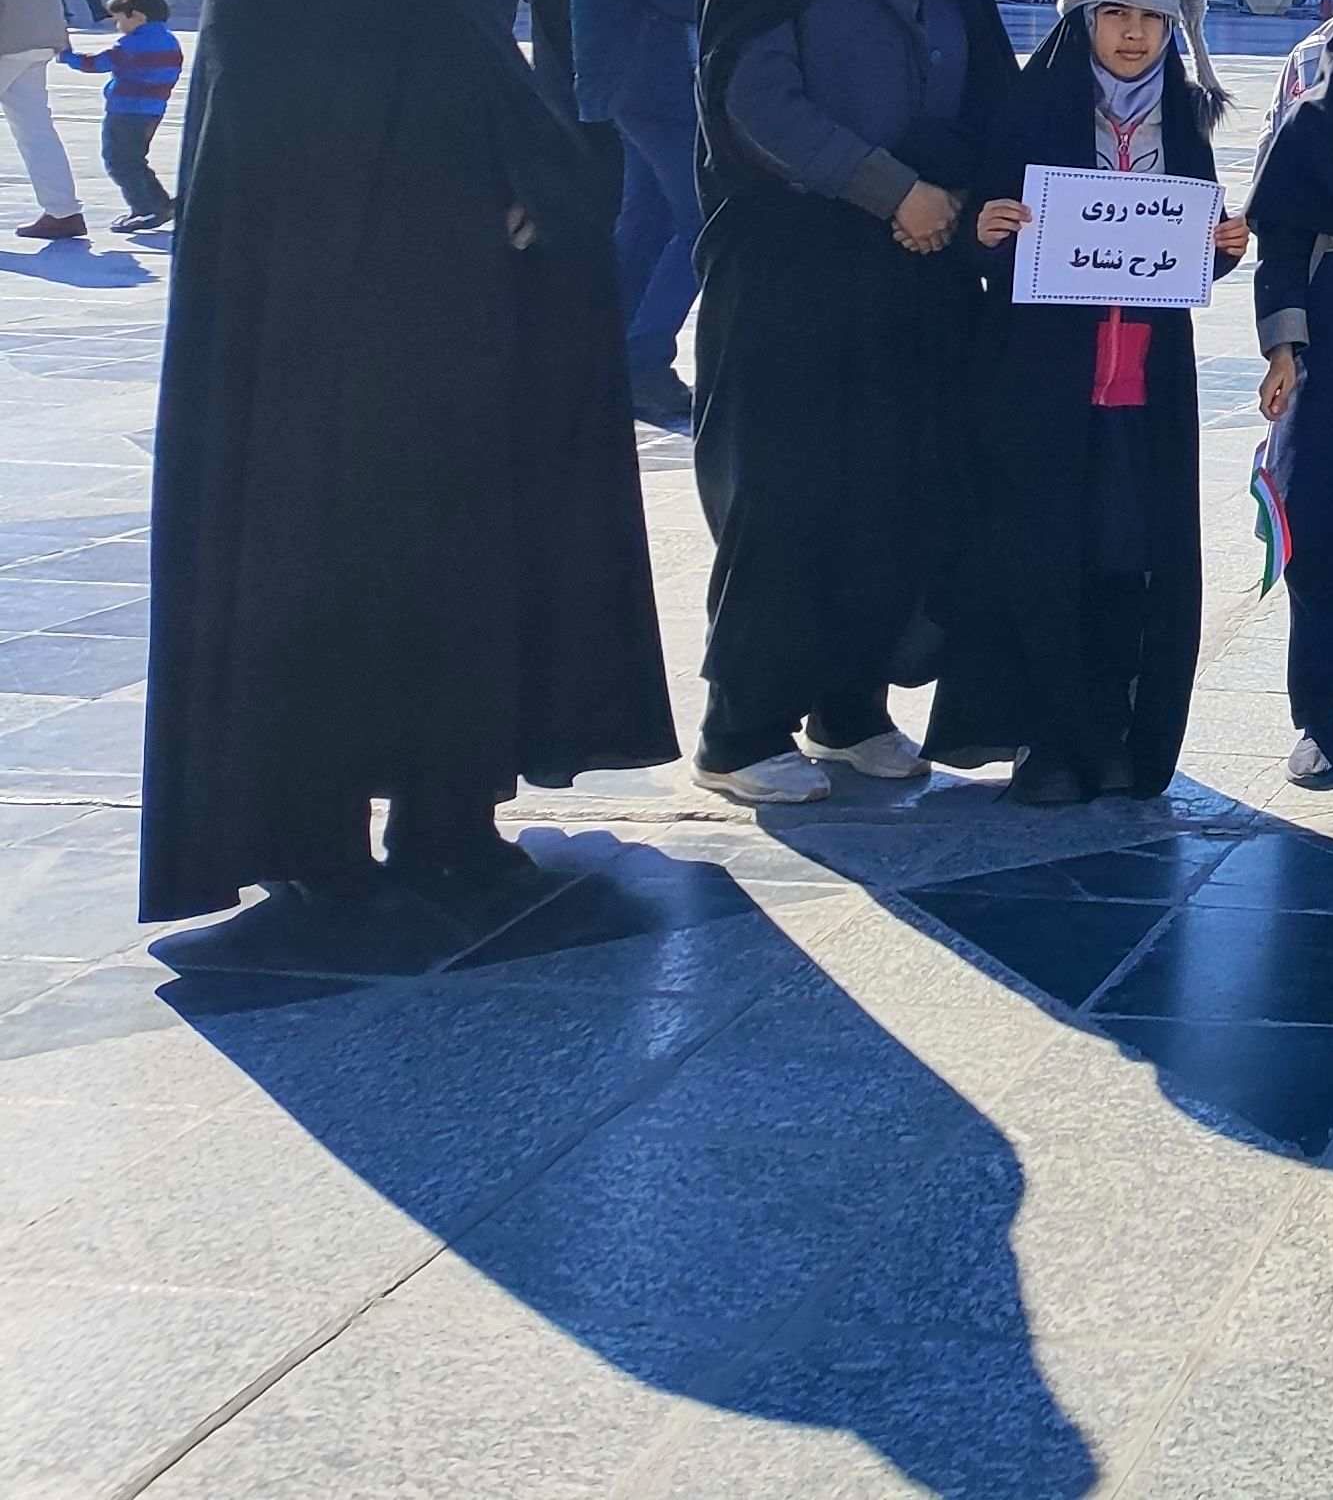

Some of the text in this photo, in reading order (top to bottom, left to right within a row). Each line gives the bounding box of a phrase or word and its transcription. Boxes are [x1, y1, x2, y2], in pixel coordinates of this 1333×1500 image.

[1081, 196, 1184, 225] پیاده روی
[1069, 247, 1178, 278] طرح نشاط
